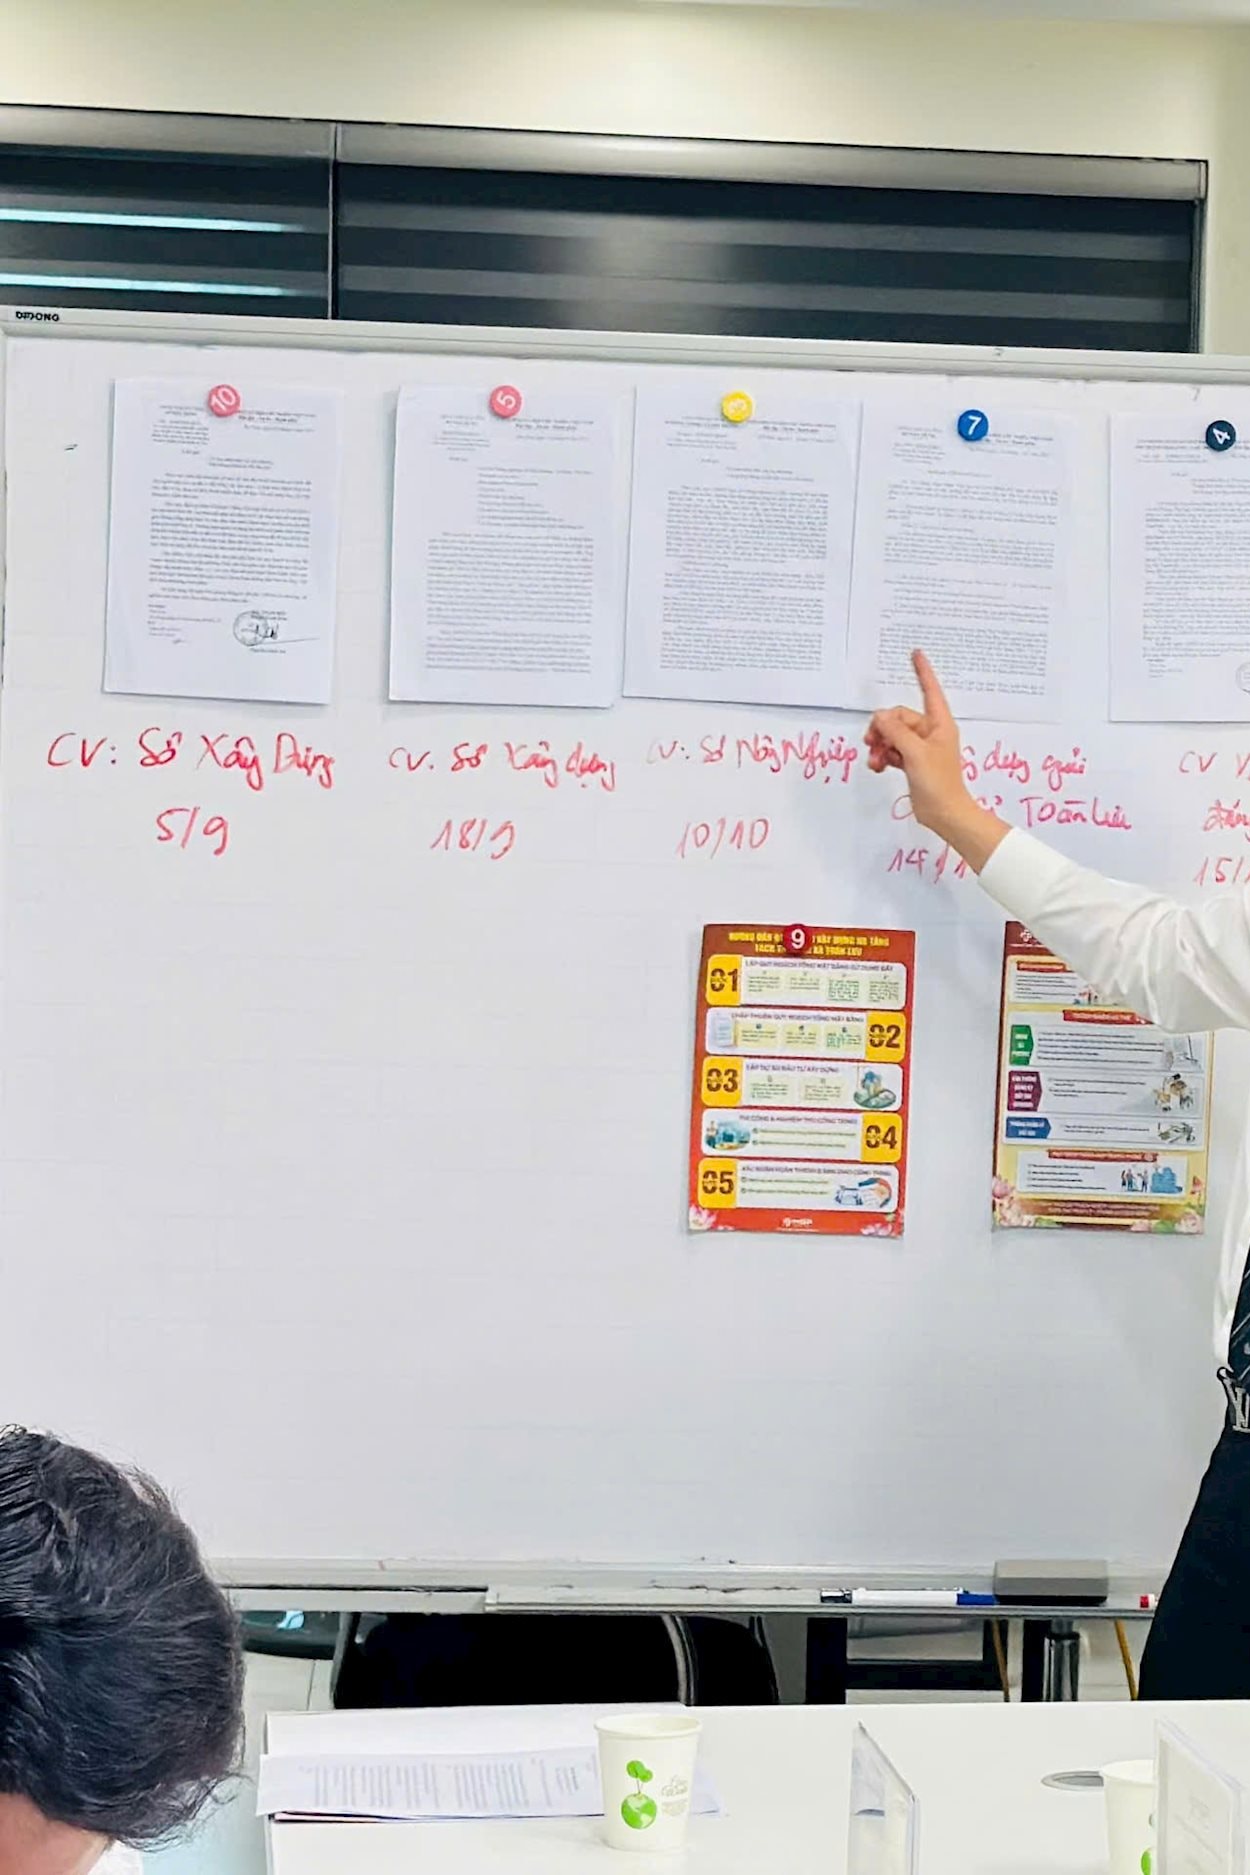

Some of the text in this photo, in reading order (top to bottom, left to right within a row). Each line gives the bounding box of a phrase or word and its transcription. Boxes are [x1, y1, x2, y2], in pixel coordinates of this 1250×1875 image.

[211, 387, 236, 411] 10
[496, 389, 516, 410] 5
[967, 414, 982, 436] 7
[1212, 427, 1231, 445] 4
[155, 806, 230, 857] 5/9
[429, 817, 517, 860] 18/9
[675, 816, 770, 860] 10/10
[791, 928, 806, 949] 9
